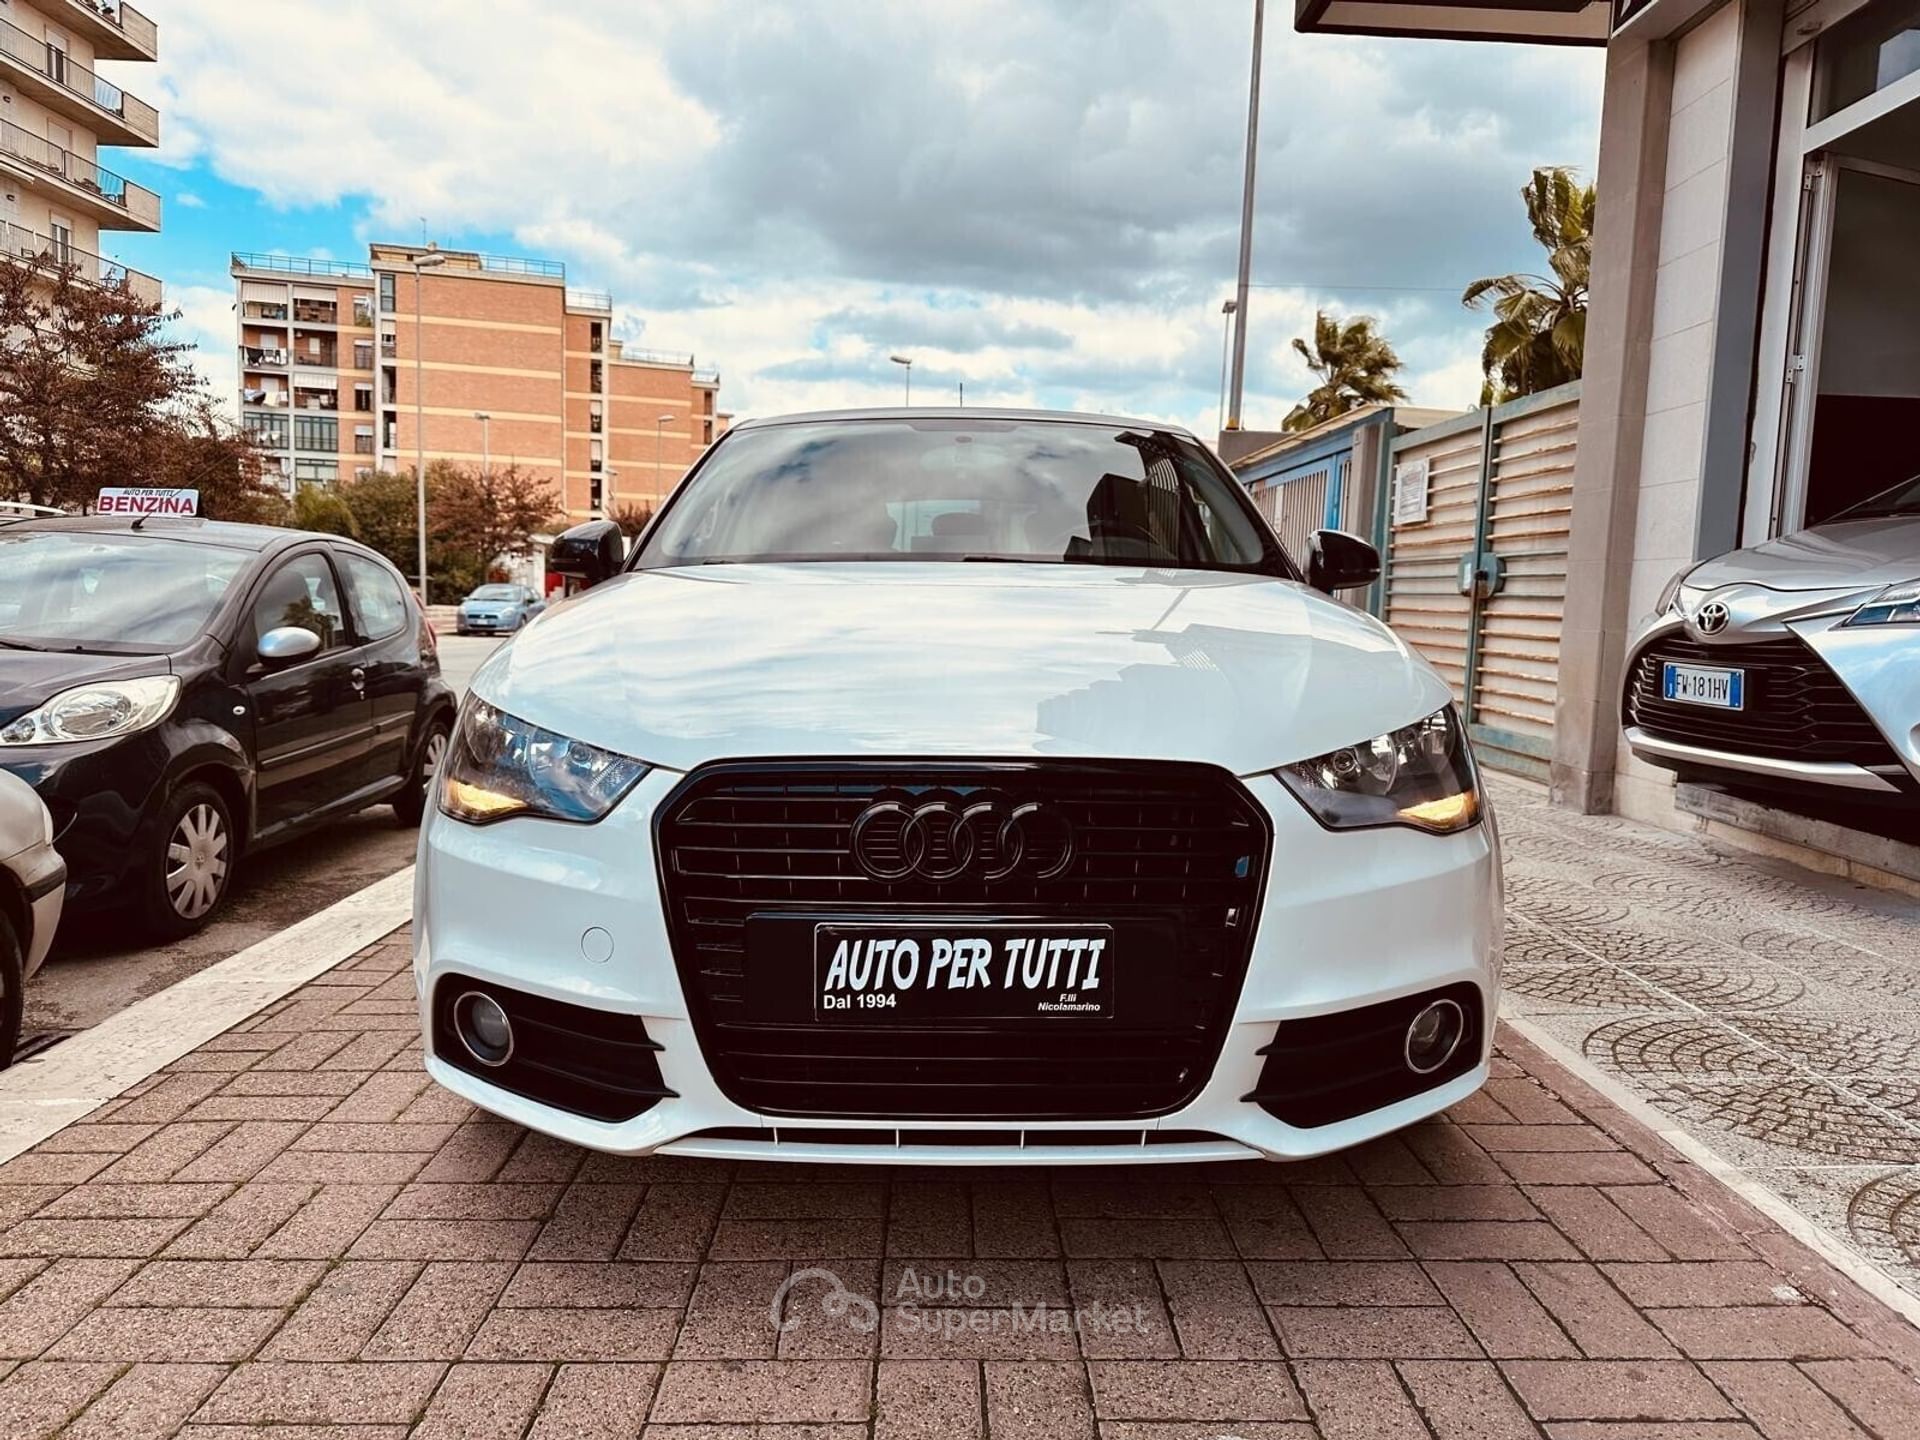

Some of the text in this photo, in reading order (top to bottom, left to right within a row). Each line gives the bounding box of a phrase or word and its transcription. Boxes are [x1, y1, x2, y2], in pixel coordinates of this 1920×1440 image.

[123, 488, 141, 496] AUTO
[155, 489, 174, 497] TUTTI
[99, 496, 194, 513] BENZINA
[824, 938, 1106, 991] AUTO PER TUTTI
[823, 993, 896, 1009] Dal 1994
[1037, 1002, 1101, 1012] Nicolamarino
